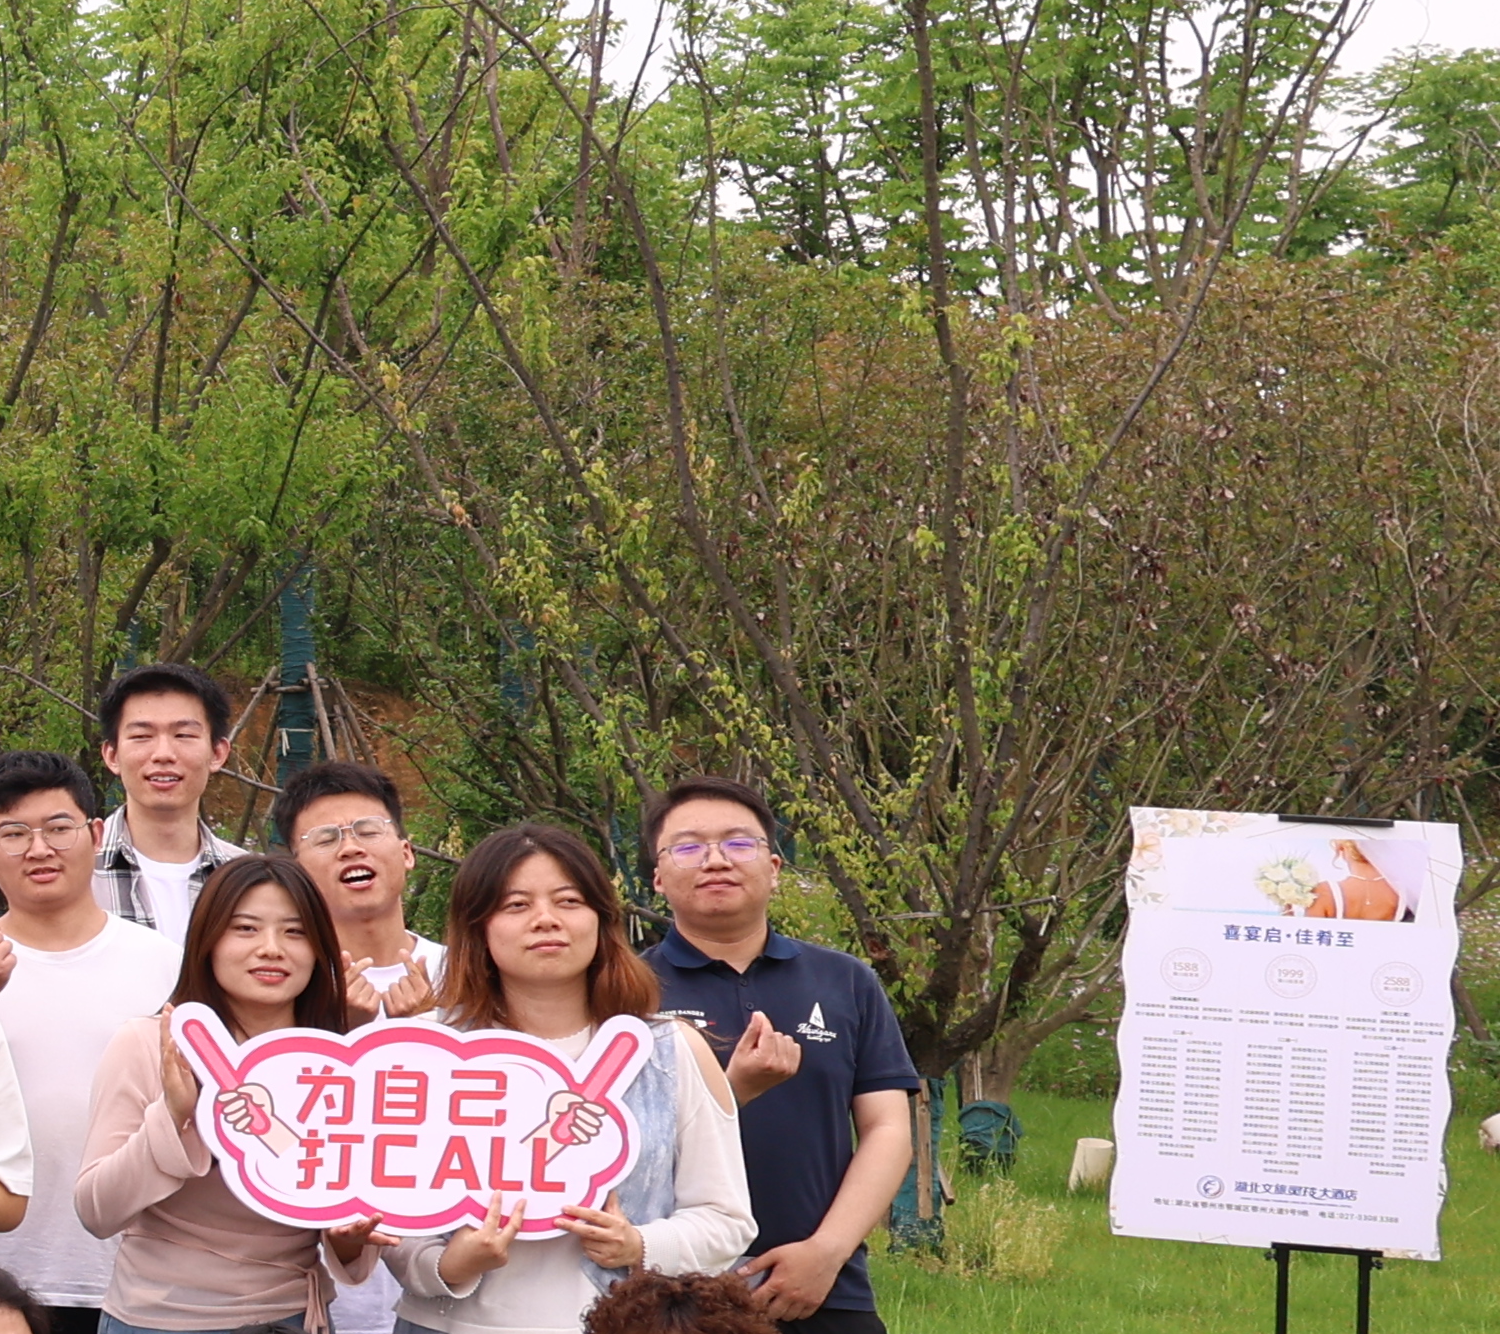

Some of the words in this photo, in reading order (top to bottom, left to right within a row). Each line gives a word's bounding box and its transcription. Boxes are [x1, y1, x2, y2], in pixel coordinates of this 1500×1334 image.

[296, 1065, 508, 1128] 为自己
[296, 1130, 567, 1195] 打CALL
